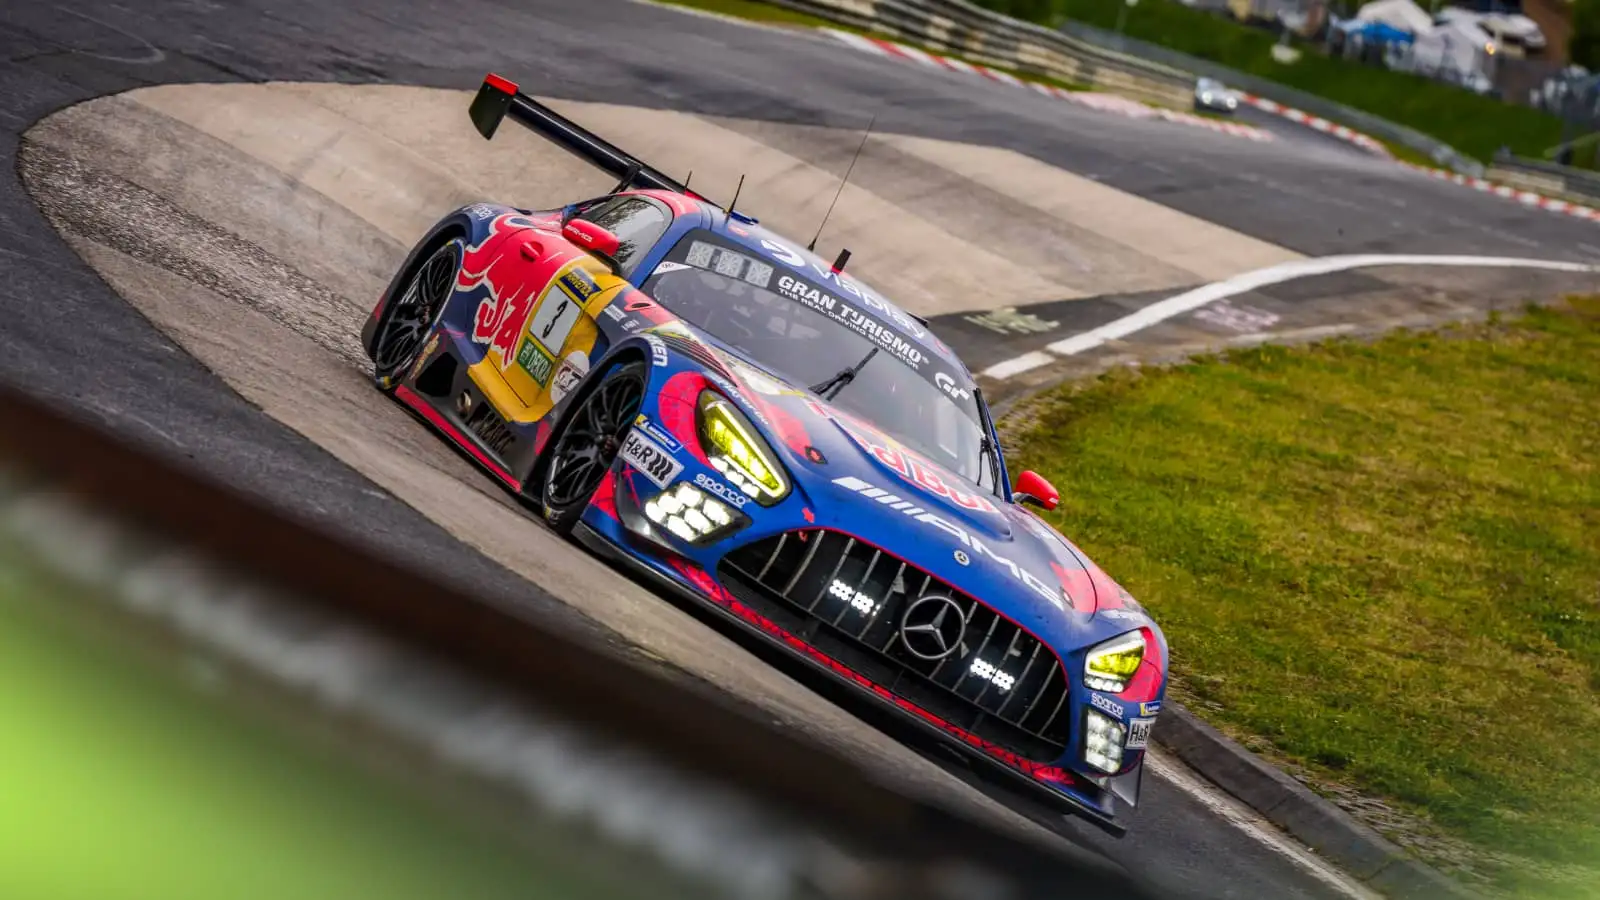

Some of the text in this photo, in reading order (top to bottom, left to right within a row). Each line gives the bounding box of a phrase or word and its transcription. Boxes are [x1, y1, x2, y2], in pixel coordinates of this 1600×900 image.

[542, 300, 568, 339] 3
[778, 275, 836, 309] GRAN
[840, 304, 922, 363] TURISMO
[778, 287, 919, 370] THE REAL DRIVING SIMULATOR
[626, 434, 653, 464] H&R
[695, 473, 747, 506] sparco
[1091, 692, 1124, 717] sparco
